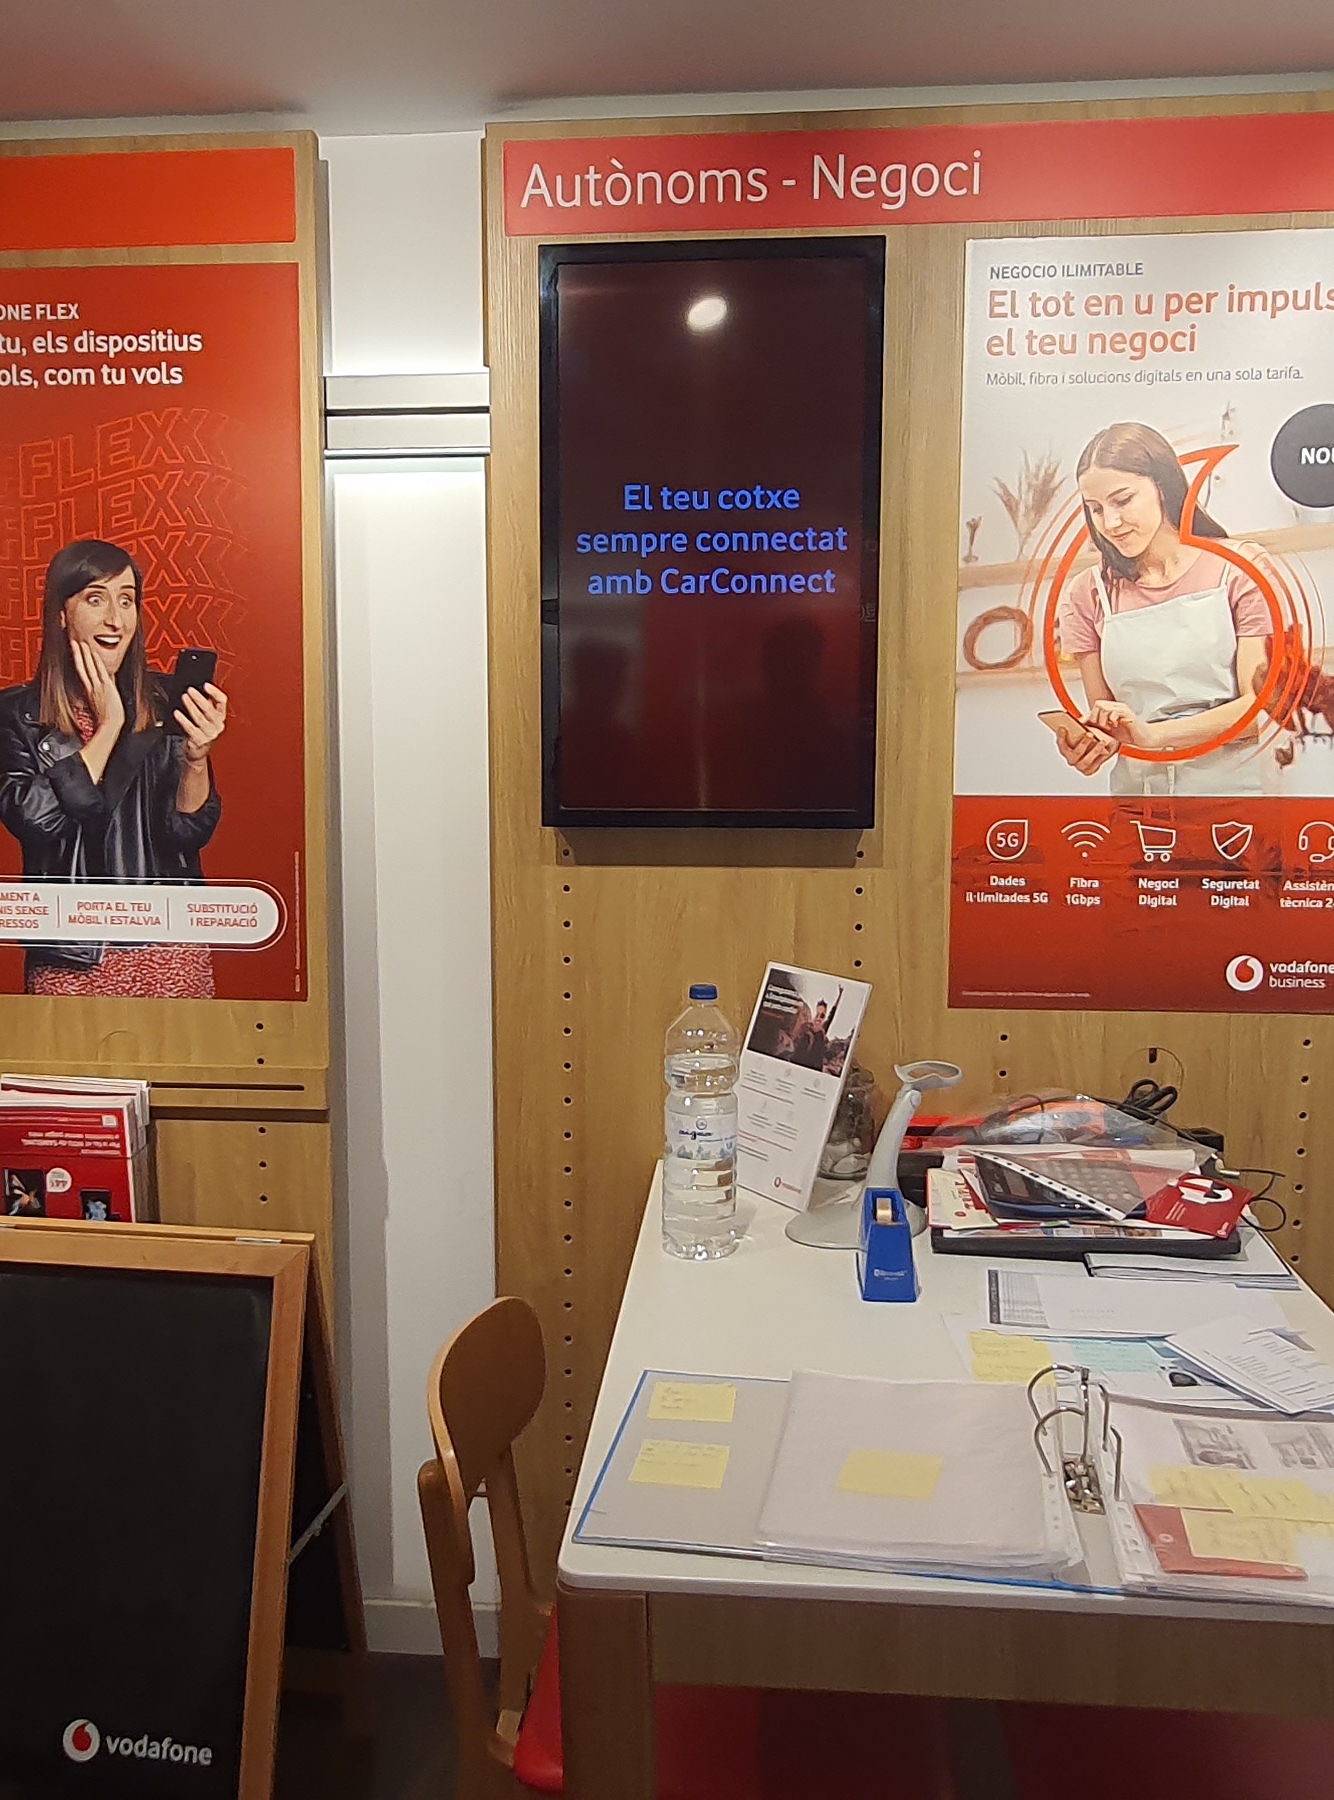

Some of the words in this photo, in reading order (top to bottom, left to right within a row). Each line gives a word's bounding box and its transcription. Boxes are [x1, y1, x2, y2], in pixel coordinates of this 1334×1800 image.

[520, 157, 769, 210] Autònoms
[781, 180, 796, 189] -
[811, 150, 984, 211] Negoci
[989, 264, 1058, 280] NEGOCIO
[1061, 262, 1144, 279] ILIMITABLE
[35, 303, 79, 321] FLEX
[987, 289, 1018, 319] El
[1028, 290, 1076, 318] tot
[1083, 293, 1123, 317] en
[1134, 293, 1154, 315] u
[1164, 290, 1219, 322] per
[32, 330, 68, 355] els
[73, 329, 203, 358] dispositius
[986, 328, 1017, 357] el
[1025, 330, 1077, 356] teu
[1087, 323, 1198, 362] negoci
[43, 367, 96, 387] com
[100, 365, 127, 386] tu
[130, 361, 184, 387] vols
[986, 370, 1027, 387] Mòbil,
[1028, 370, 1059, 386] fibra
[1061, 371, 1066, 385] i
[1068, 368, 1132, 386] solucions
[1133, 367, 1183, 387] digitals
[1185, 370, 1204, 383] en
[1205, 369, 1232, 383] una
[1233, 366, 1263, 382] sola
[1265, 363, 1304, 382] tarifa.
[623, 483, 653, 511] El
[660, 487, 711, 511] teu
[716, 485, 801, 512] cotxe
[575, 531, 688, 557] sempre
[695, 525, 849, 552] connectat
[587, 567, 652, 597] amb
[659, 567, 836, 596] CarConnect
[995, 831, 1019, 848] 5G
[989, 874, 1026, 887] Dades
[1069, 877, 1099, 889] Fibra
[1138, 877, 1180, 891] Negoci
[1202, 877, 1261, 892] Seguretat
[31, 892, 41, 902] A
[1032, 891, 1049, 904] 5G
[1065, 893, 1101, 907] 1Gbps
[1138, 894, 1177, 908] Digital
[1210, 894, 1250, 908] Digital
[1279, 895, 1323, 909] tècnica
[14, 904, 50, 916] SENSE
[76, 901, 114, 912] PORTA
[115, 901, 128, 912] EL
[131, 901, 152, 912] TEU
[186, 901, 259, 914] SUBSTITUCIÓ
[67, 913, 103, 926] MÒBIL
[109, 914, 162, 927] ESTALVIA
[195, 915, 258, 928] REPARACIÓ
[1268, 975, 1326, 989] business
[105, 1733, 213, 1767] vodafone
